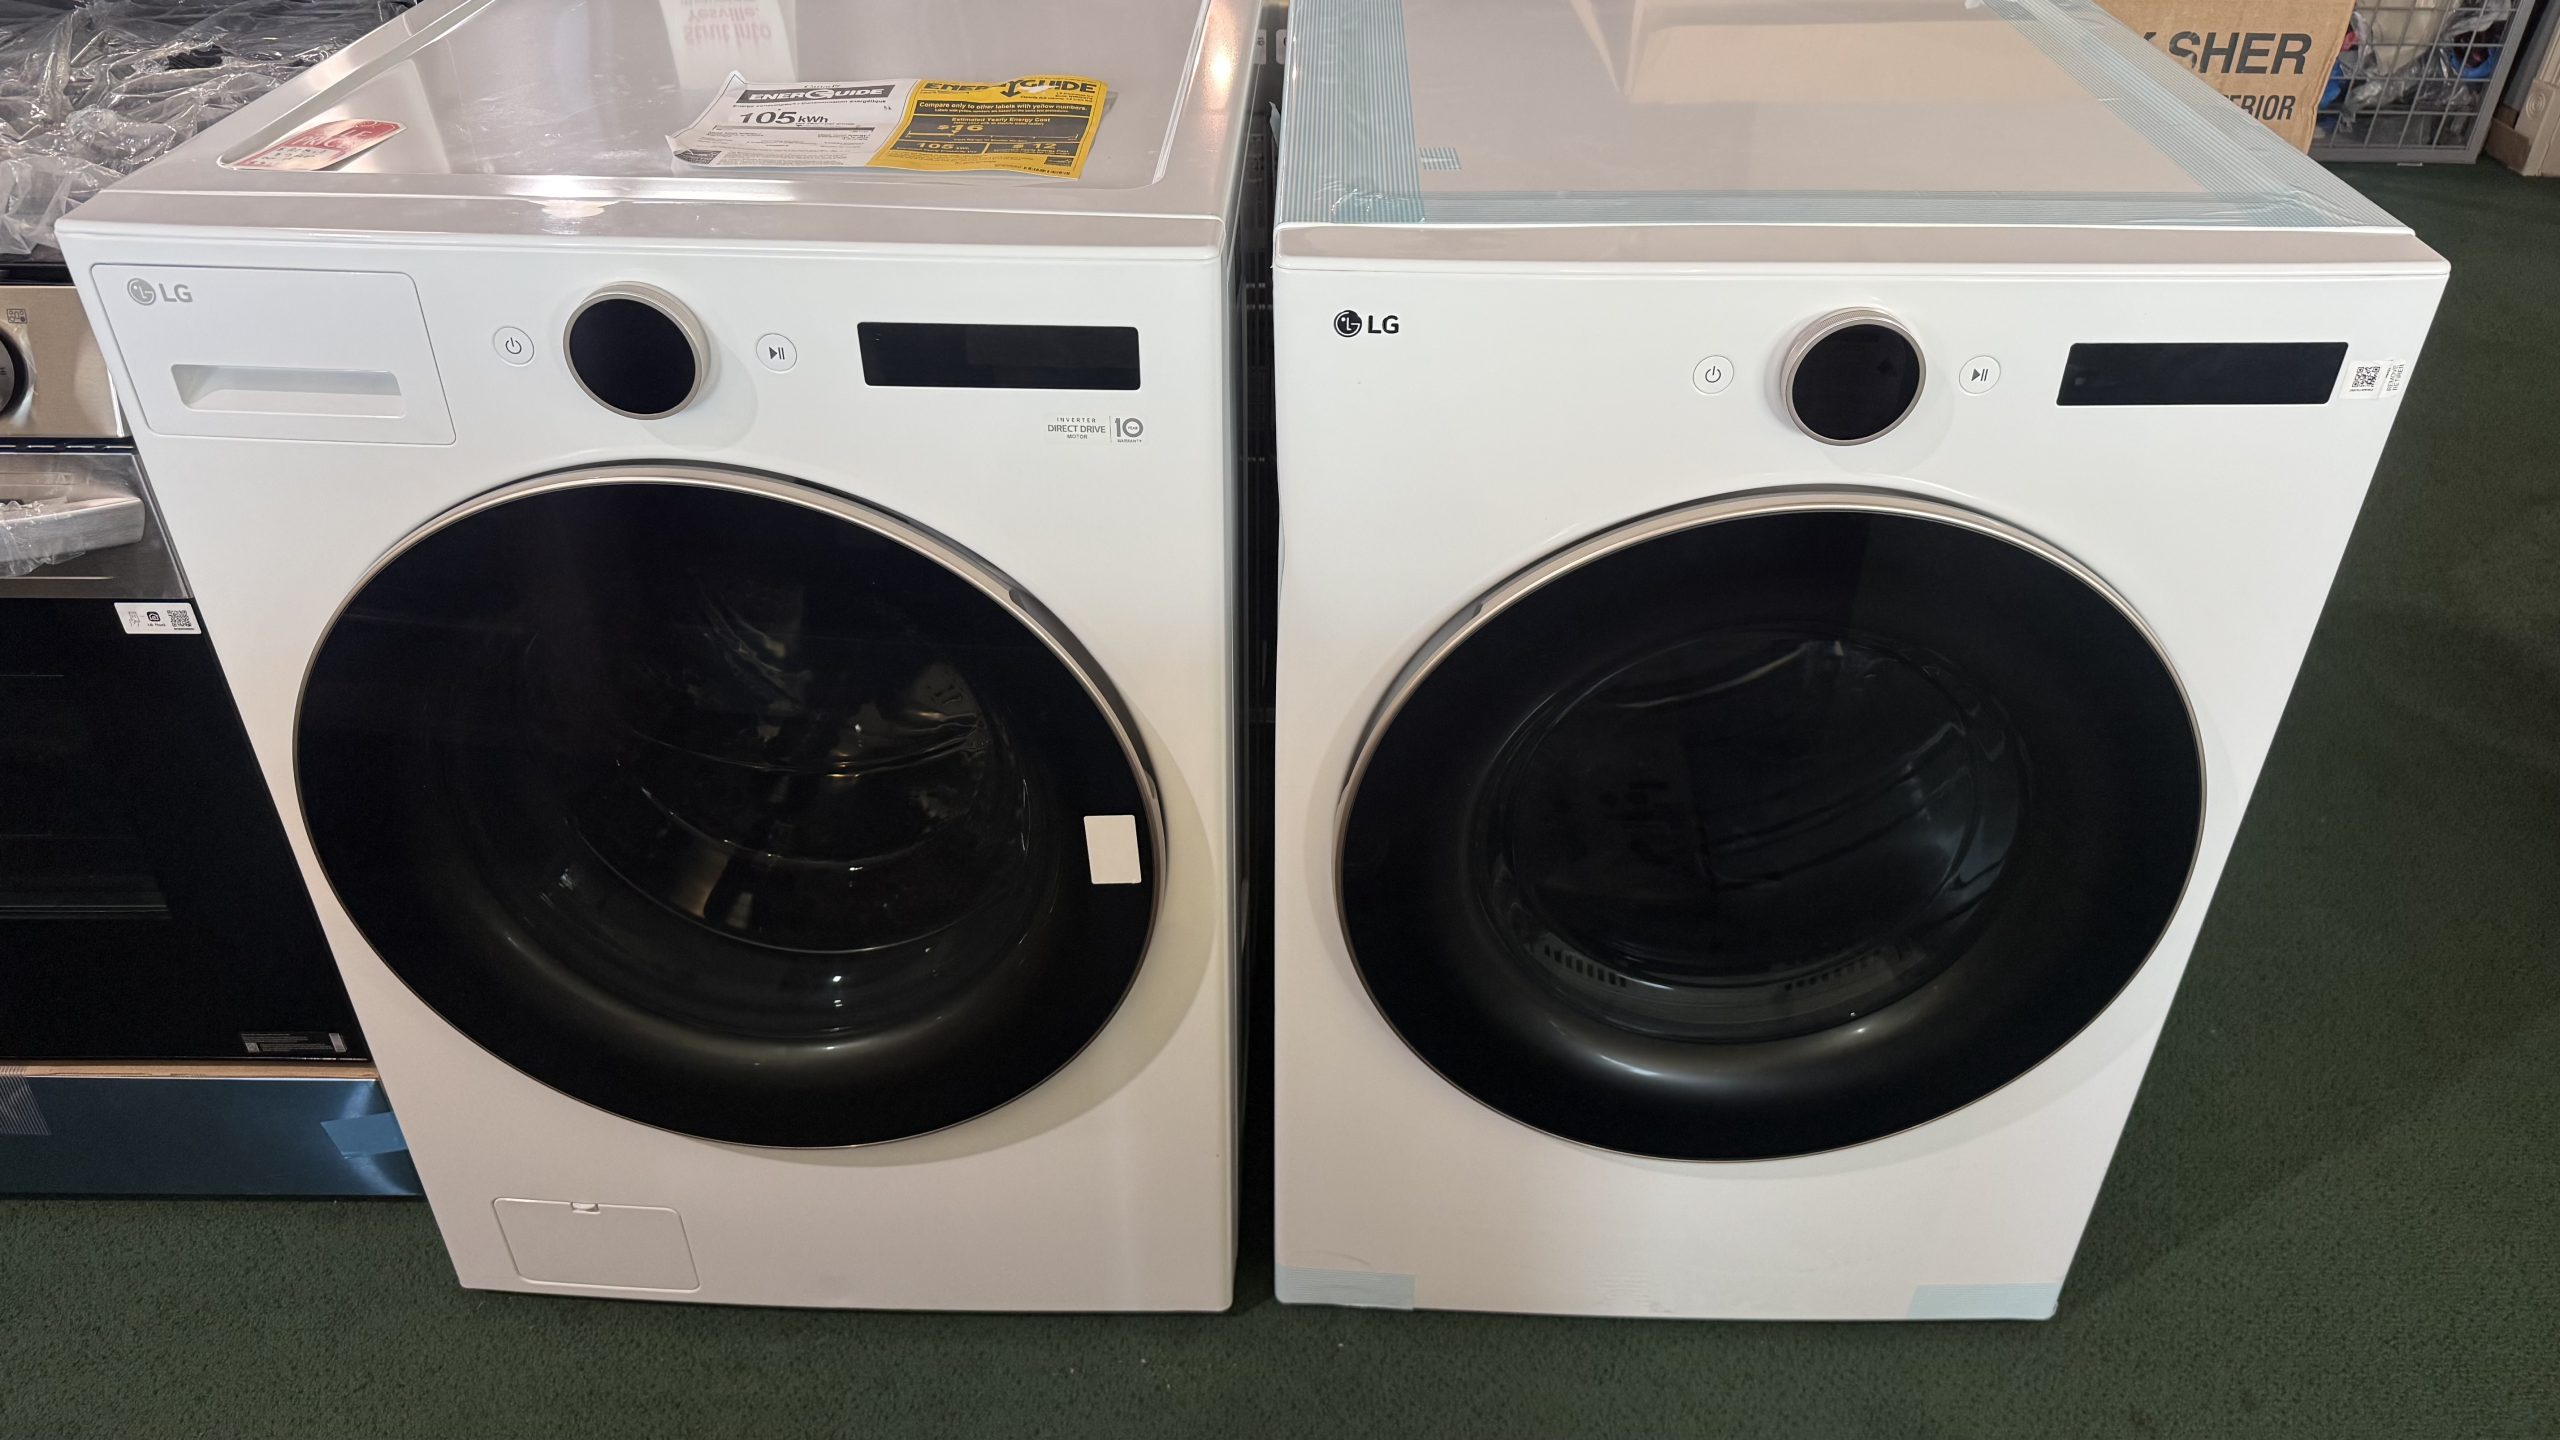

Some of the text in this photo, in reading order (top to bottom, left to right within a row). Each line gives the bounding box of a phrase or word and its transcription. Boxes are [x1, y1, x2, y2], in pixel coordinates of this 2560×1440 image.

[919, 101, 950, 109] Compare
[951, 102, 967, 110] only
[740, 111, 829, 124] 105 kWh
[158, 283, 194, 303] LG
[1367, 314, 1400, 335] LG
[1047, 424, 1107, 434] DIRECT DRIVE
[1114, 417, 1145, 438] 10
